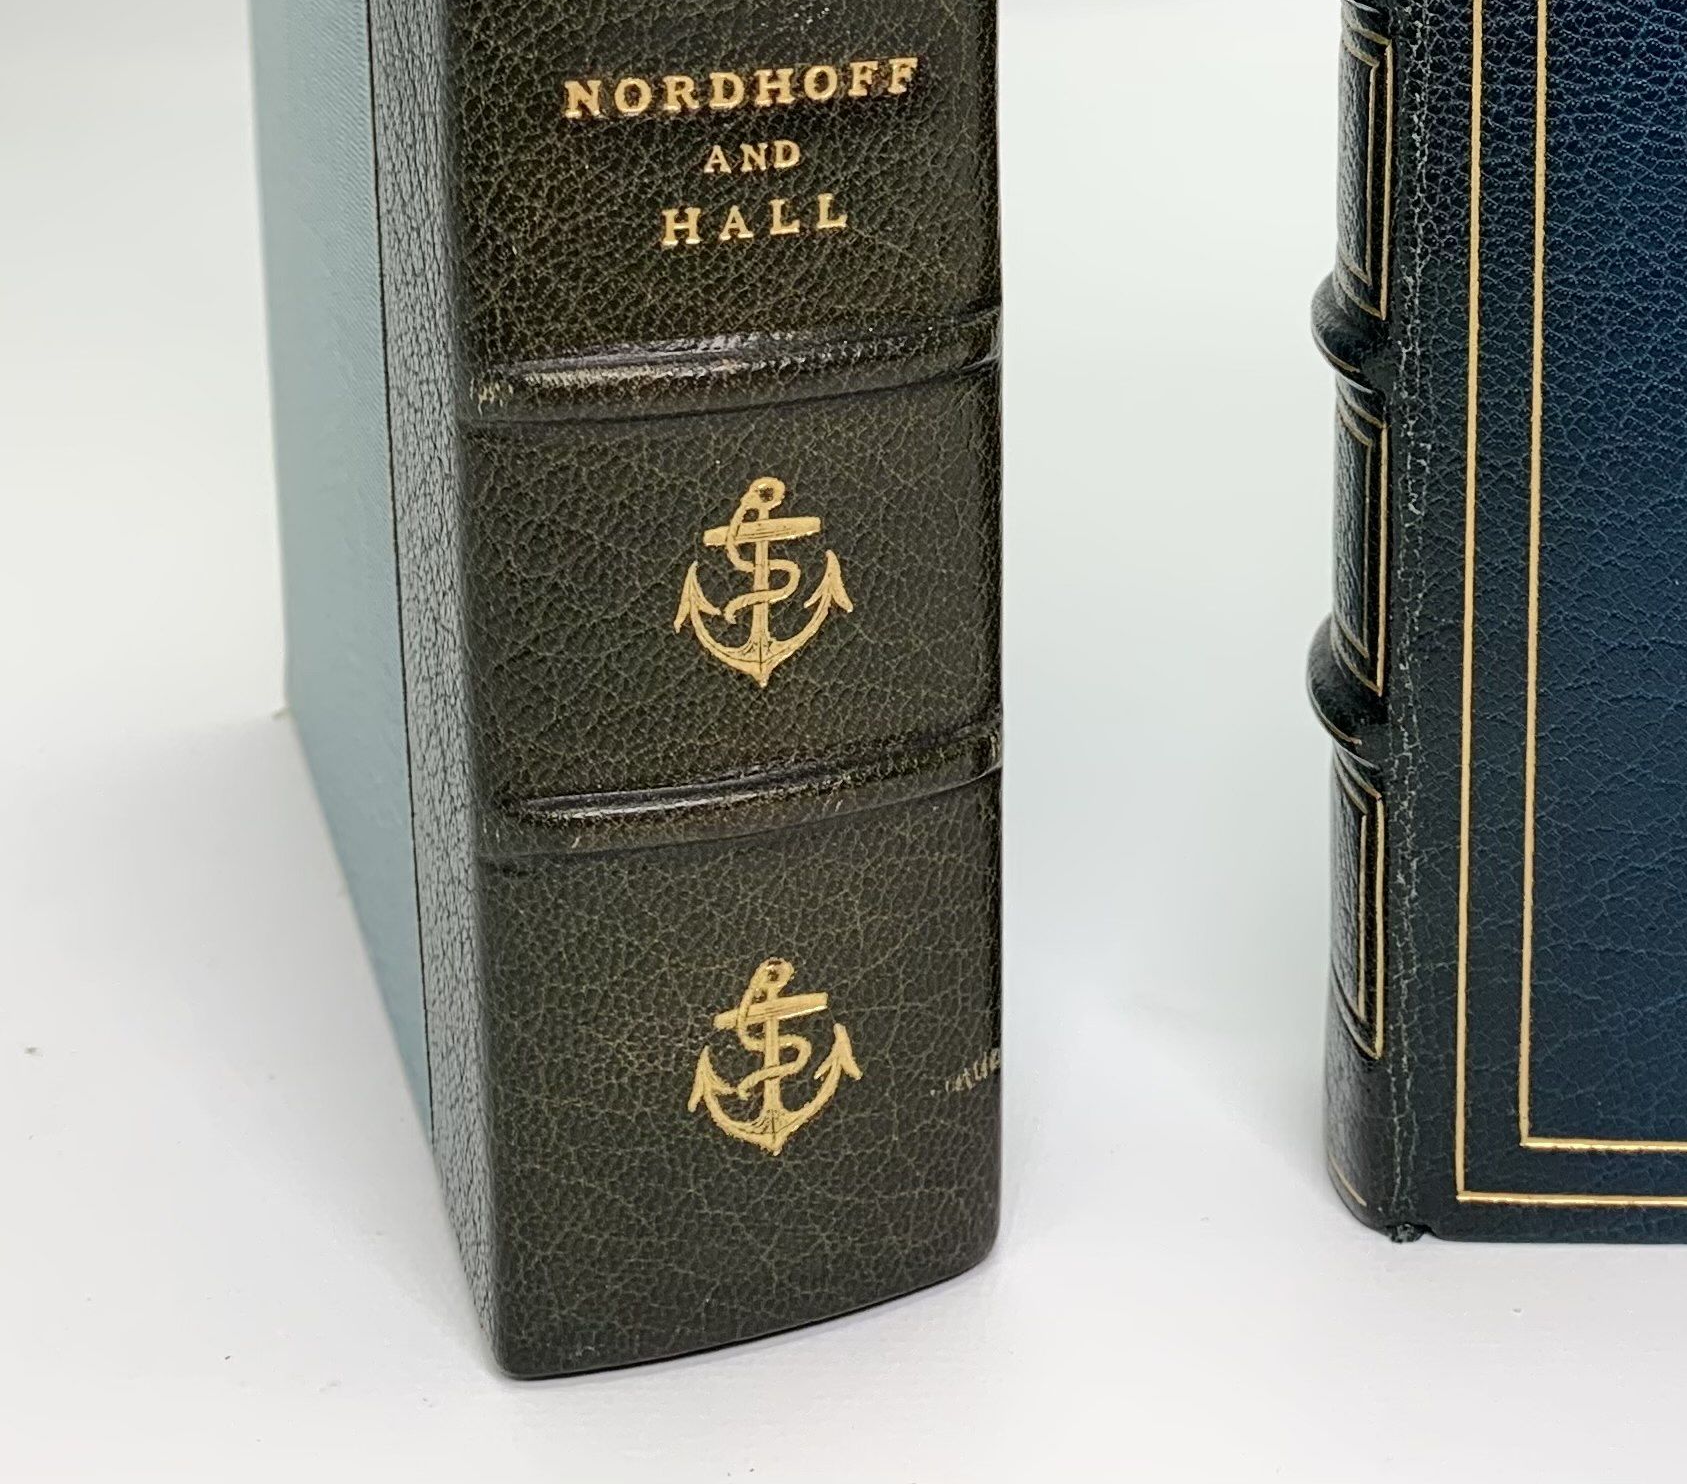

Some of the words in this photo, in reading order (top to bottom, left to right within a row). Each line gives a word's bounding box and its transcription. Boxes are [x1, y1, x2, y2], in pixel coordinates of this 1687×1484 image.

[564, 57, 919, 118] NORDHOFF
[703, 139, 801, 174] AND
[661, 192, 848, 247] HALL
